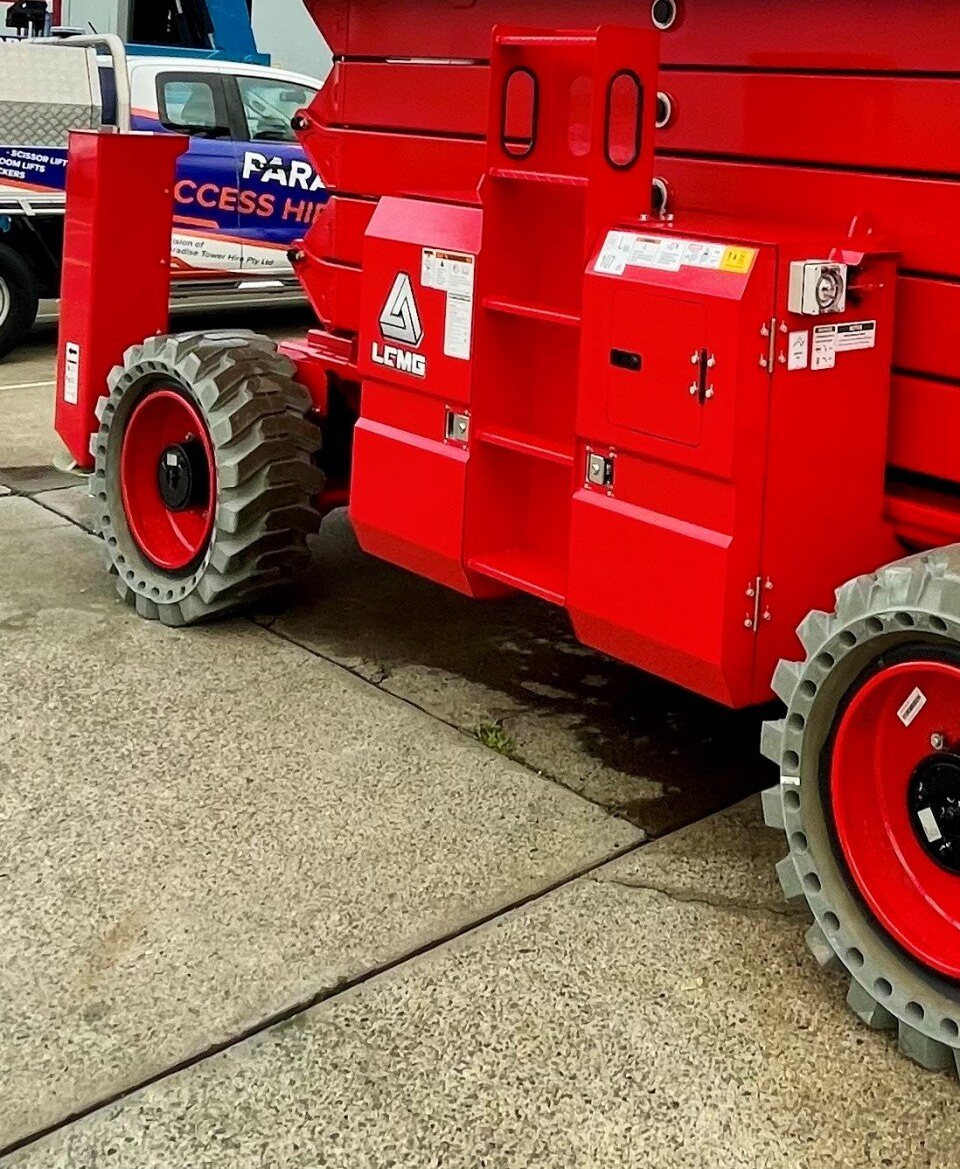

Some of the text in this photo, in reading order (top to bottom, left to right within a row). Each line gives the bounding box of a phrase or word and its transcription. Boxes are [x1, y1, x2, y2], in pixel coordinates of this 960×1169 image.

[0, 157, 46, 172] OOM LIFTS
[10, 149, 69, 167] SCISSOR LIFT
[174, 180, 276, 217] CCESS
[201, 250, 226, 260] Tower
[245, 256, 260, 266] Pty
